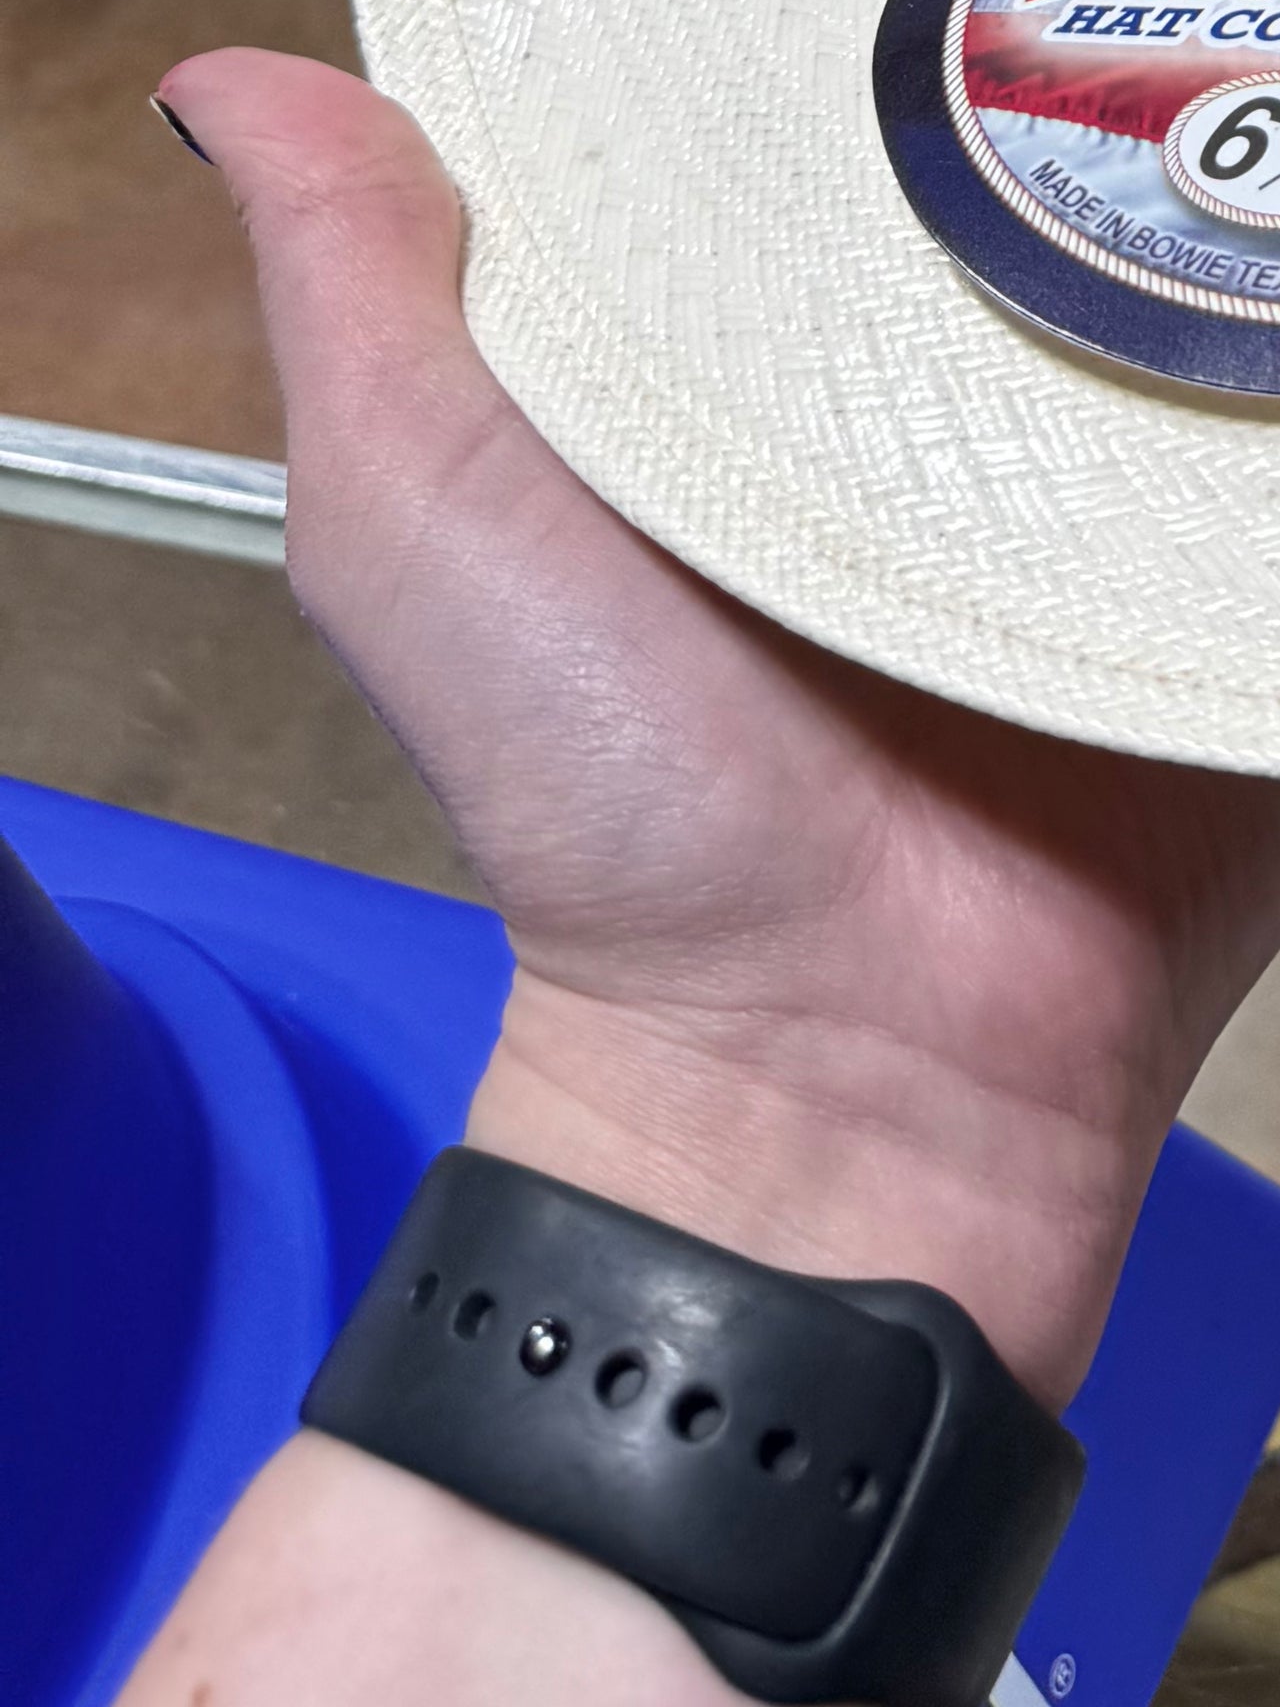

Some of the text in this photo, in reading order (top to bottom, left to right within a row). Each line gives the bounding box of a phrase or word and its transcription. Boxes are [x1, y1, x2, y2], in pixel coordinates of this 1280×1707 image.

[1053, 3, 1204, 38] HAT
[1029, 158, 1097, 221] MADE
[1099, 206, 1134, 241] IN
[1127, 224, 1233, 281] BOWIE
